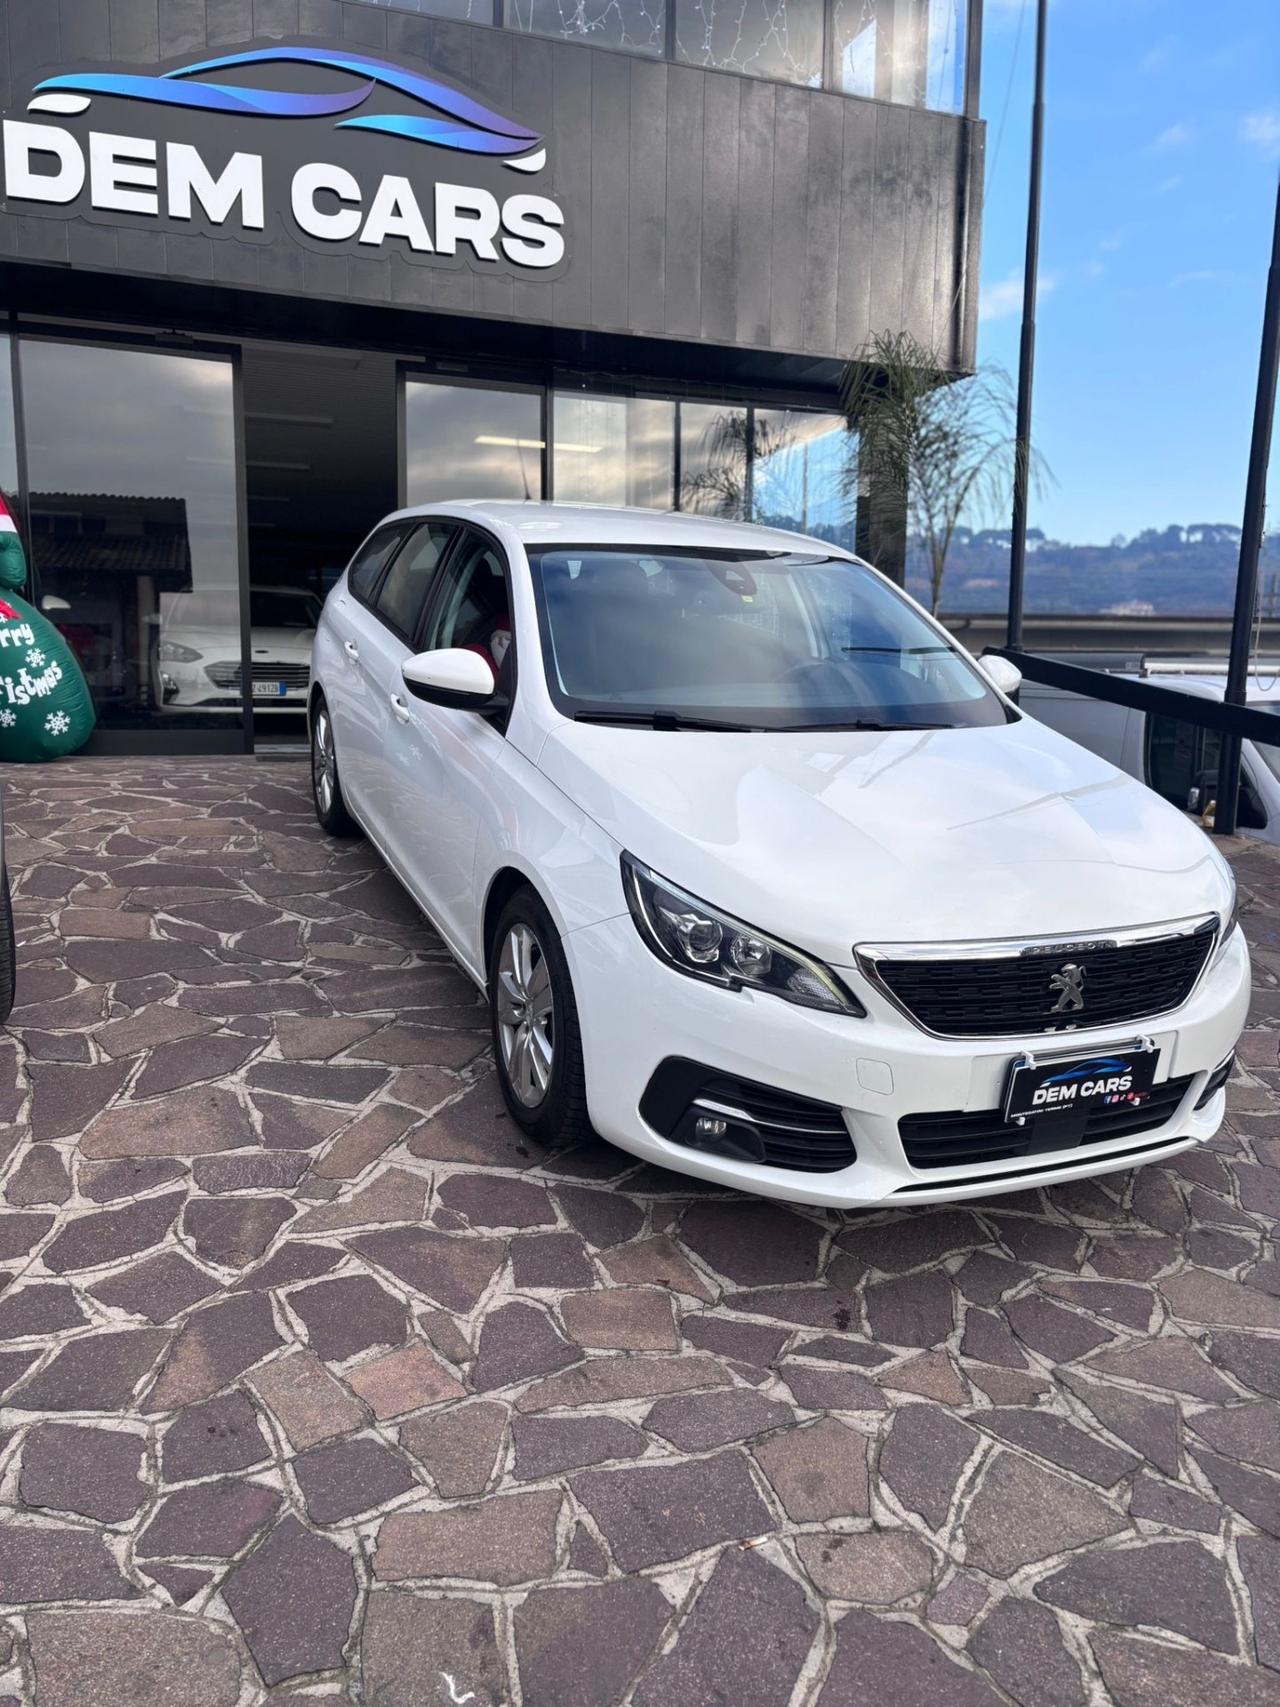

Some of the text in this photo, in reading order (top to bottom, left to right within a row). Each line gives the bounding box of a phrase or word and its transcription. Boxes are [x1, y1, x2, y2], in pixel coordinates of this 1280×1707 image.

[2, 119, 566, 268] DEM CARS
[0, 623, 36, 648] rry
[0, 660, 63, 705] istmas
[1032, 941, 1107, 956] PEUGEOT
[1031, 1083, 1077, 1105] DEM
[1080, 1075, 1133, 1097] CARS
